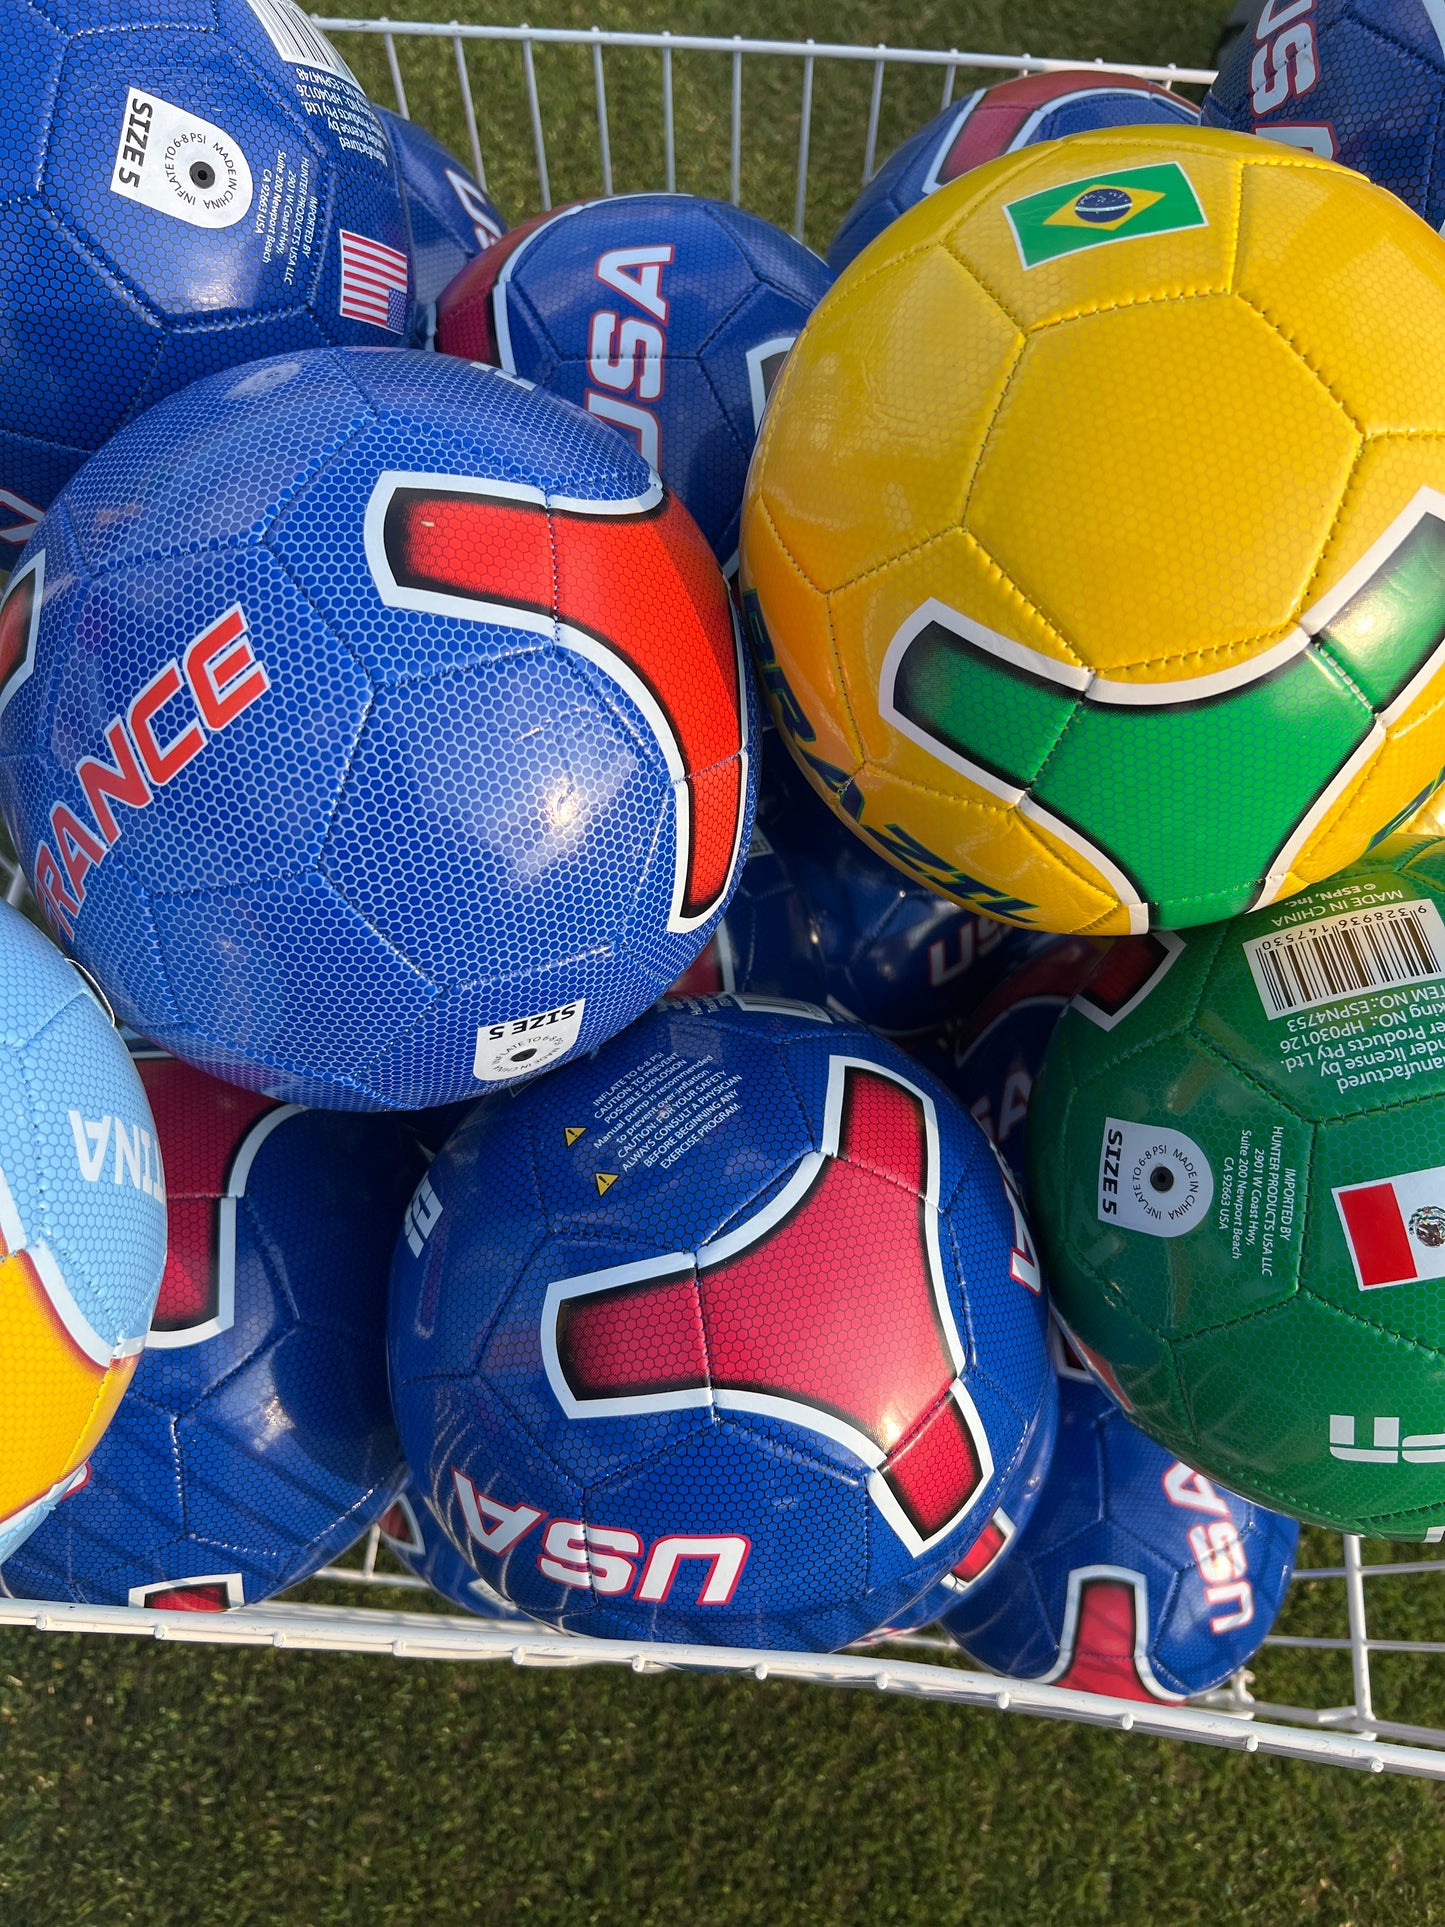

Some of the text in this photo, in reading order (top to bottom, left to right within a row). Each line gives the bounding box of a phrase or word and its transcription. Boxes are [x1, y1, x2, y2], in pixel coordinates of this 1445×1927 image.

[301, 101, 323, 116] Ltd.
[328, 116, 342, 135] by
[118, 98, 153, 188] SIZE 5
[165, 132, 206, 206] INFLATE TO 6-8 PSI
[203, 142, 238, 210] MADE IN CHINA
[255, 169, 272, 234] CA 92663 USA
[262, 150, 286, 263] Suite 200 Newport Beach
[275, 170, 297, 255] 2901 W Coast Hwy,
[283, 156, 309, 286] HUNTER PRODUCTS USA LLC
[302, 195, 318, 259] IMPORTED BY
[1271, 889, 1404, 927] MADE IN CHINA
[1284, 896, 1313, 907] Inc.
[1316, 885, 1361, 901] ESPN,
[489, 1004, 577, 1040] SIZE 5
[1287, 1000, 1370, 1032] ESPN4753
[1409, 1002, 1445, 1020] king
[1411, 984, 1445, 1003] TEM
[1279, 1020, 1365, 1054] HP030126
[1280, 1054, 1314, 1073] Ltd.
[1317, 1044, 1346, 1061] Pty
[1320, 1039, 1445, 1077] nder license by
[1349, 1025, 1426, 1048] Products
[592, 1052, 665, 1107] INFLATE TO 6-8 PSI
[593, 1054, 714, 1150] Manual pump is recommended
[594, 1052, 680, 1119] CAUTION: TO PREVENT
[604, 1059, 688, 1125] POSSIBLE EXPLOSION
[615, 1068, 713, 1144] to prevent over-inflation.
[1336, 1056, 1445, 1094] anufactured
[617, 1069, 727, 1158] CAUTION: FOR YOUR SAFETY
[621, 1074, 743, 1172] ALWAYS CONSULT A PHYSICIAN
[643, 1088, 739, 1168] BEFORE BEGINNING ANY
[660, 1102, 743, 1169] EXERCISE PROGRAM.
[1102, 1128, 1123, 1216] SIZE 5
[1133, 1144, 1167, 1220] INFLATE TO 6-8 PSI
[1168, 1148, 1199, 1220] MADE IN CHINA
[1218, 1156, 1234, 1231] CA 92663 USA
[1232, 1129, 1252, 1260] Suite 200 Newport Beach
[1245, 1148, 1265, 1246] 2901 W Coast Hwy,
[1261, 1125, 1284, 1277] HUNTER PRODUCTS USA LLC
[1280, 1167, 1296, 1241] IMPORTED BY
[451, 1467, 751, 1606] USA
[1161, 1460, 1255, 1634] USA
